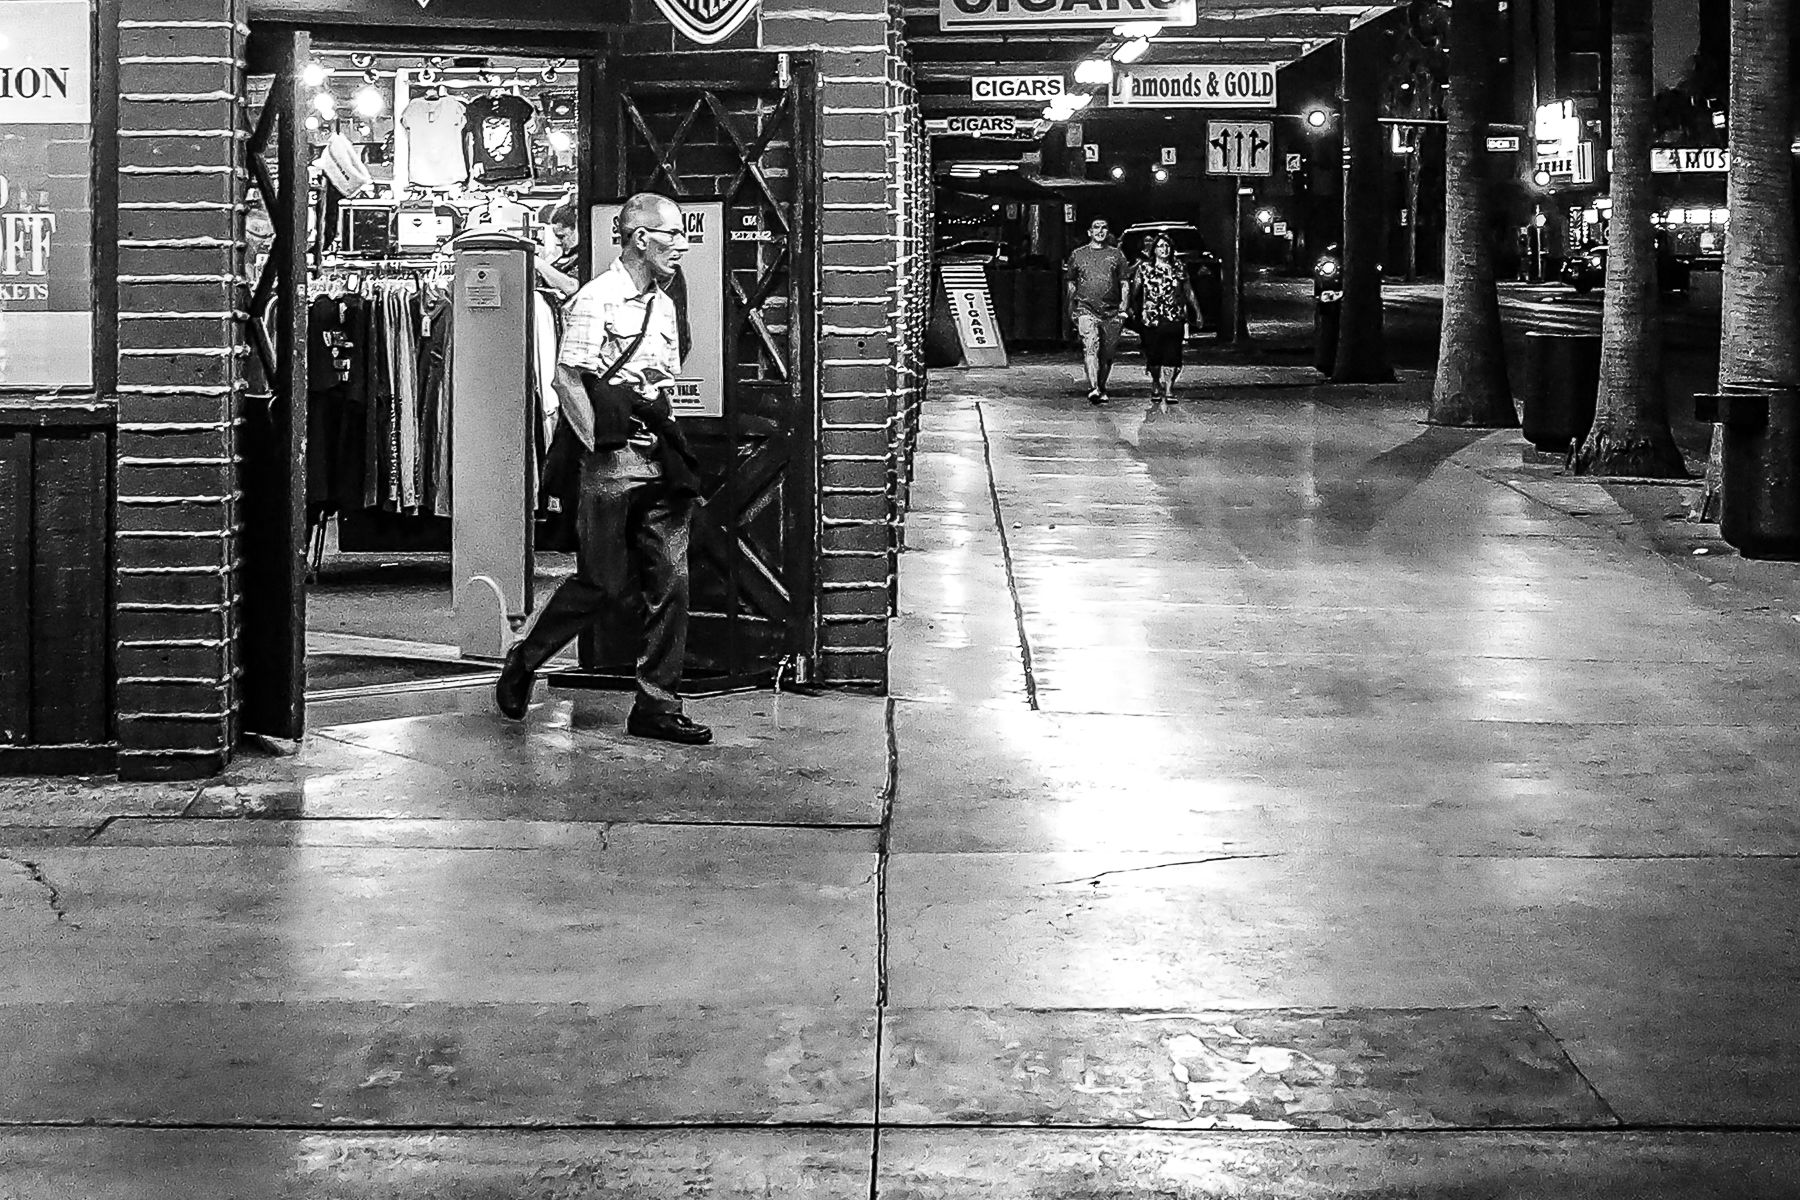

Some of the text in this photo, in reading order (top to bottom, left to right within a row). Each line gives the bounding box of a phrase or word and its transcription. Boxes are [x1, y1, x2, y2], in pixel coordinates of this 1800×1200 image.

[975, 80, 1062, 97] CIGARS
[1112, 71, 1274, 98] amonds & GOLD
[949, 117, 1014, 132] CIGARS
[0, 213, 57, 275] FF
[964, 292, 987, 345] CIGARS
